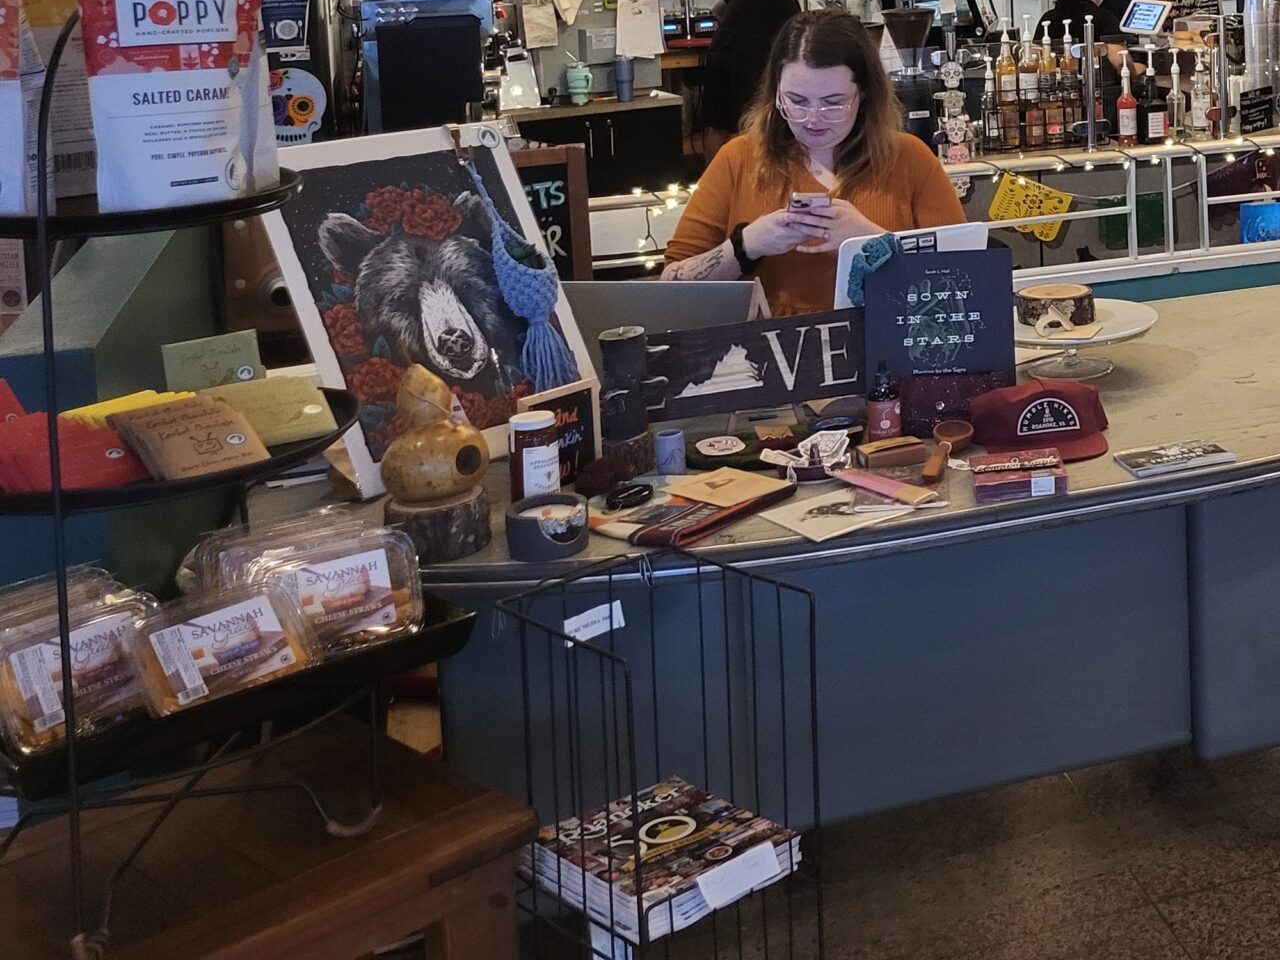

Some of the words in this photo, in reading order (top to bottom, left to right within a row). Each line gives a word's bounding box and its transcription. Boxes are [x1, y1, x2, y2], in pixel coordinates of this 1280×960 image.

[132, 0, 225, 28] POPPY
[133, 90, 181, 106] SALTED
[907, 291, 969, 302] SOWN
[896, 315, 923, 325] IN
[935, 312, 981, 323] THE
[904, 334, 975, 347] STARS
[306, 560, 378, 587] SAVANNAH
[191, 607, 264, 640] SAVANNAH
[53, 624, 127, 660] SVANNAH
